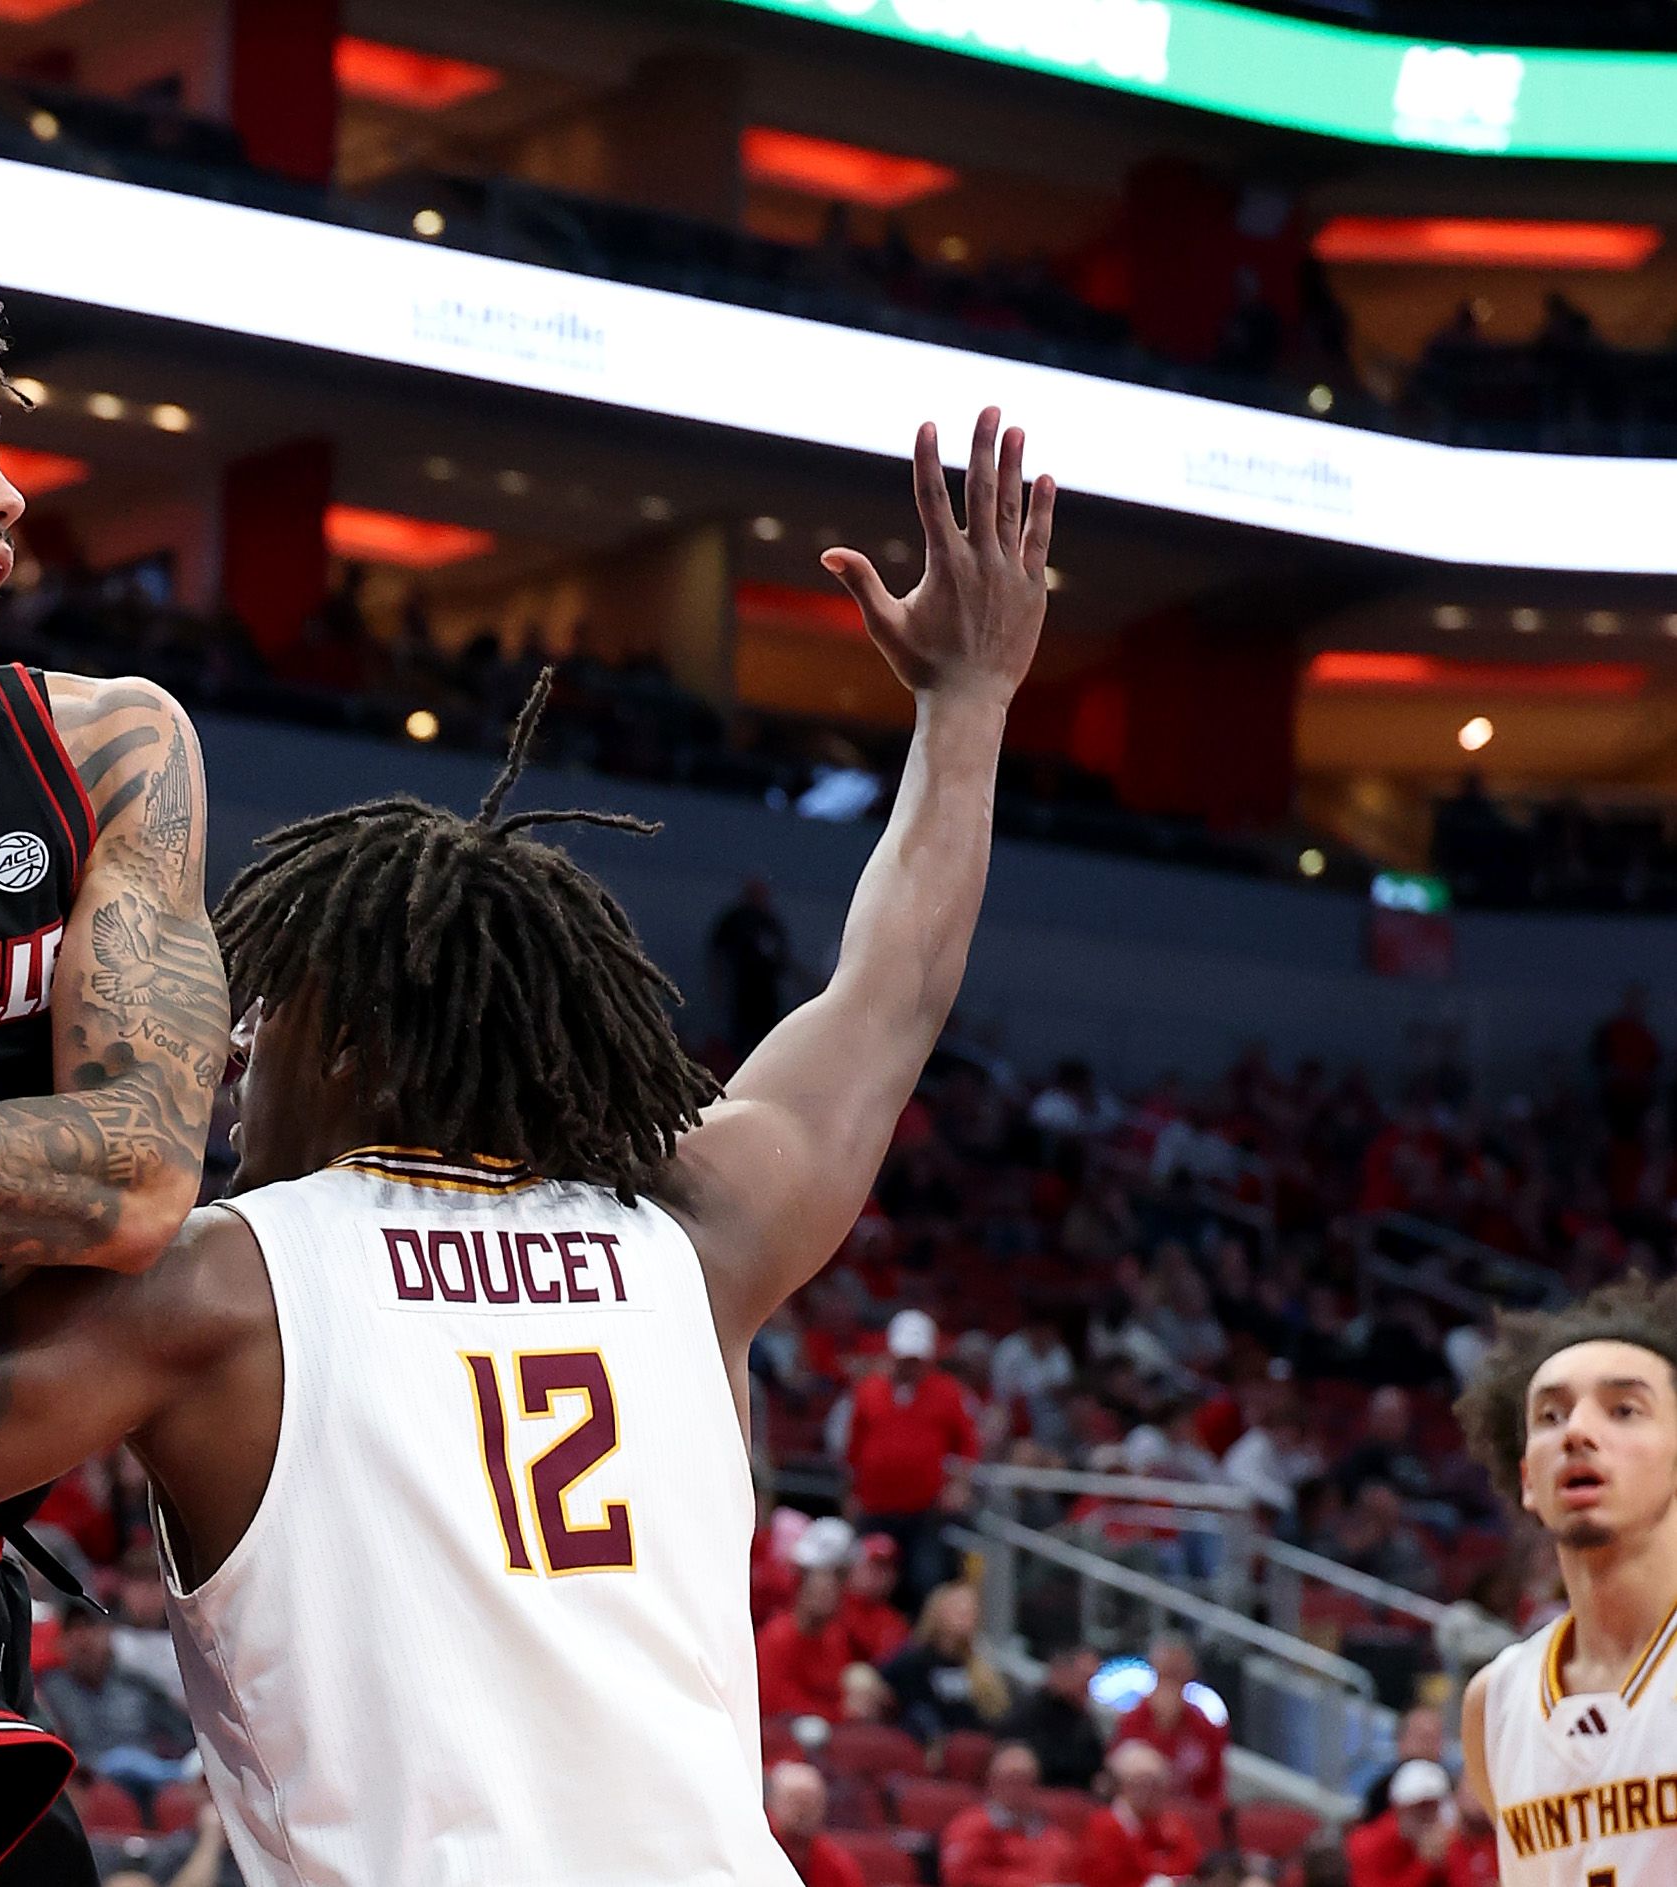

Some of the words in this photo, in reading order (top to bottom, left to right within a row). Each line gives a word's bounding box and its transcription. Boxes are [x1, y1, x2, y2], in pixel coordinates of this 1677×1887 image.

[379, 1227, 628, 1304] DOUCET
[455, 1346, 637, 1578] 12
[1502, 1773, 1677, 1858] WINTHRO
